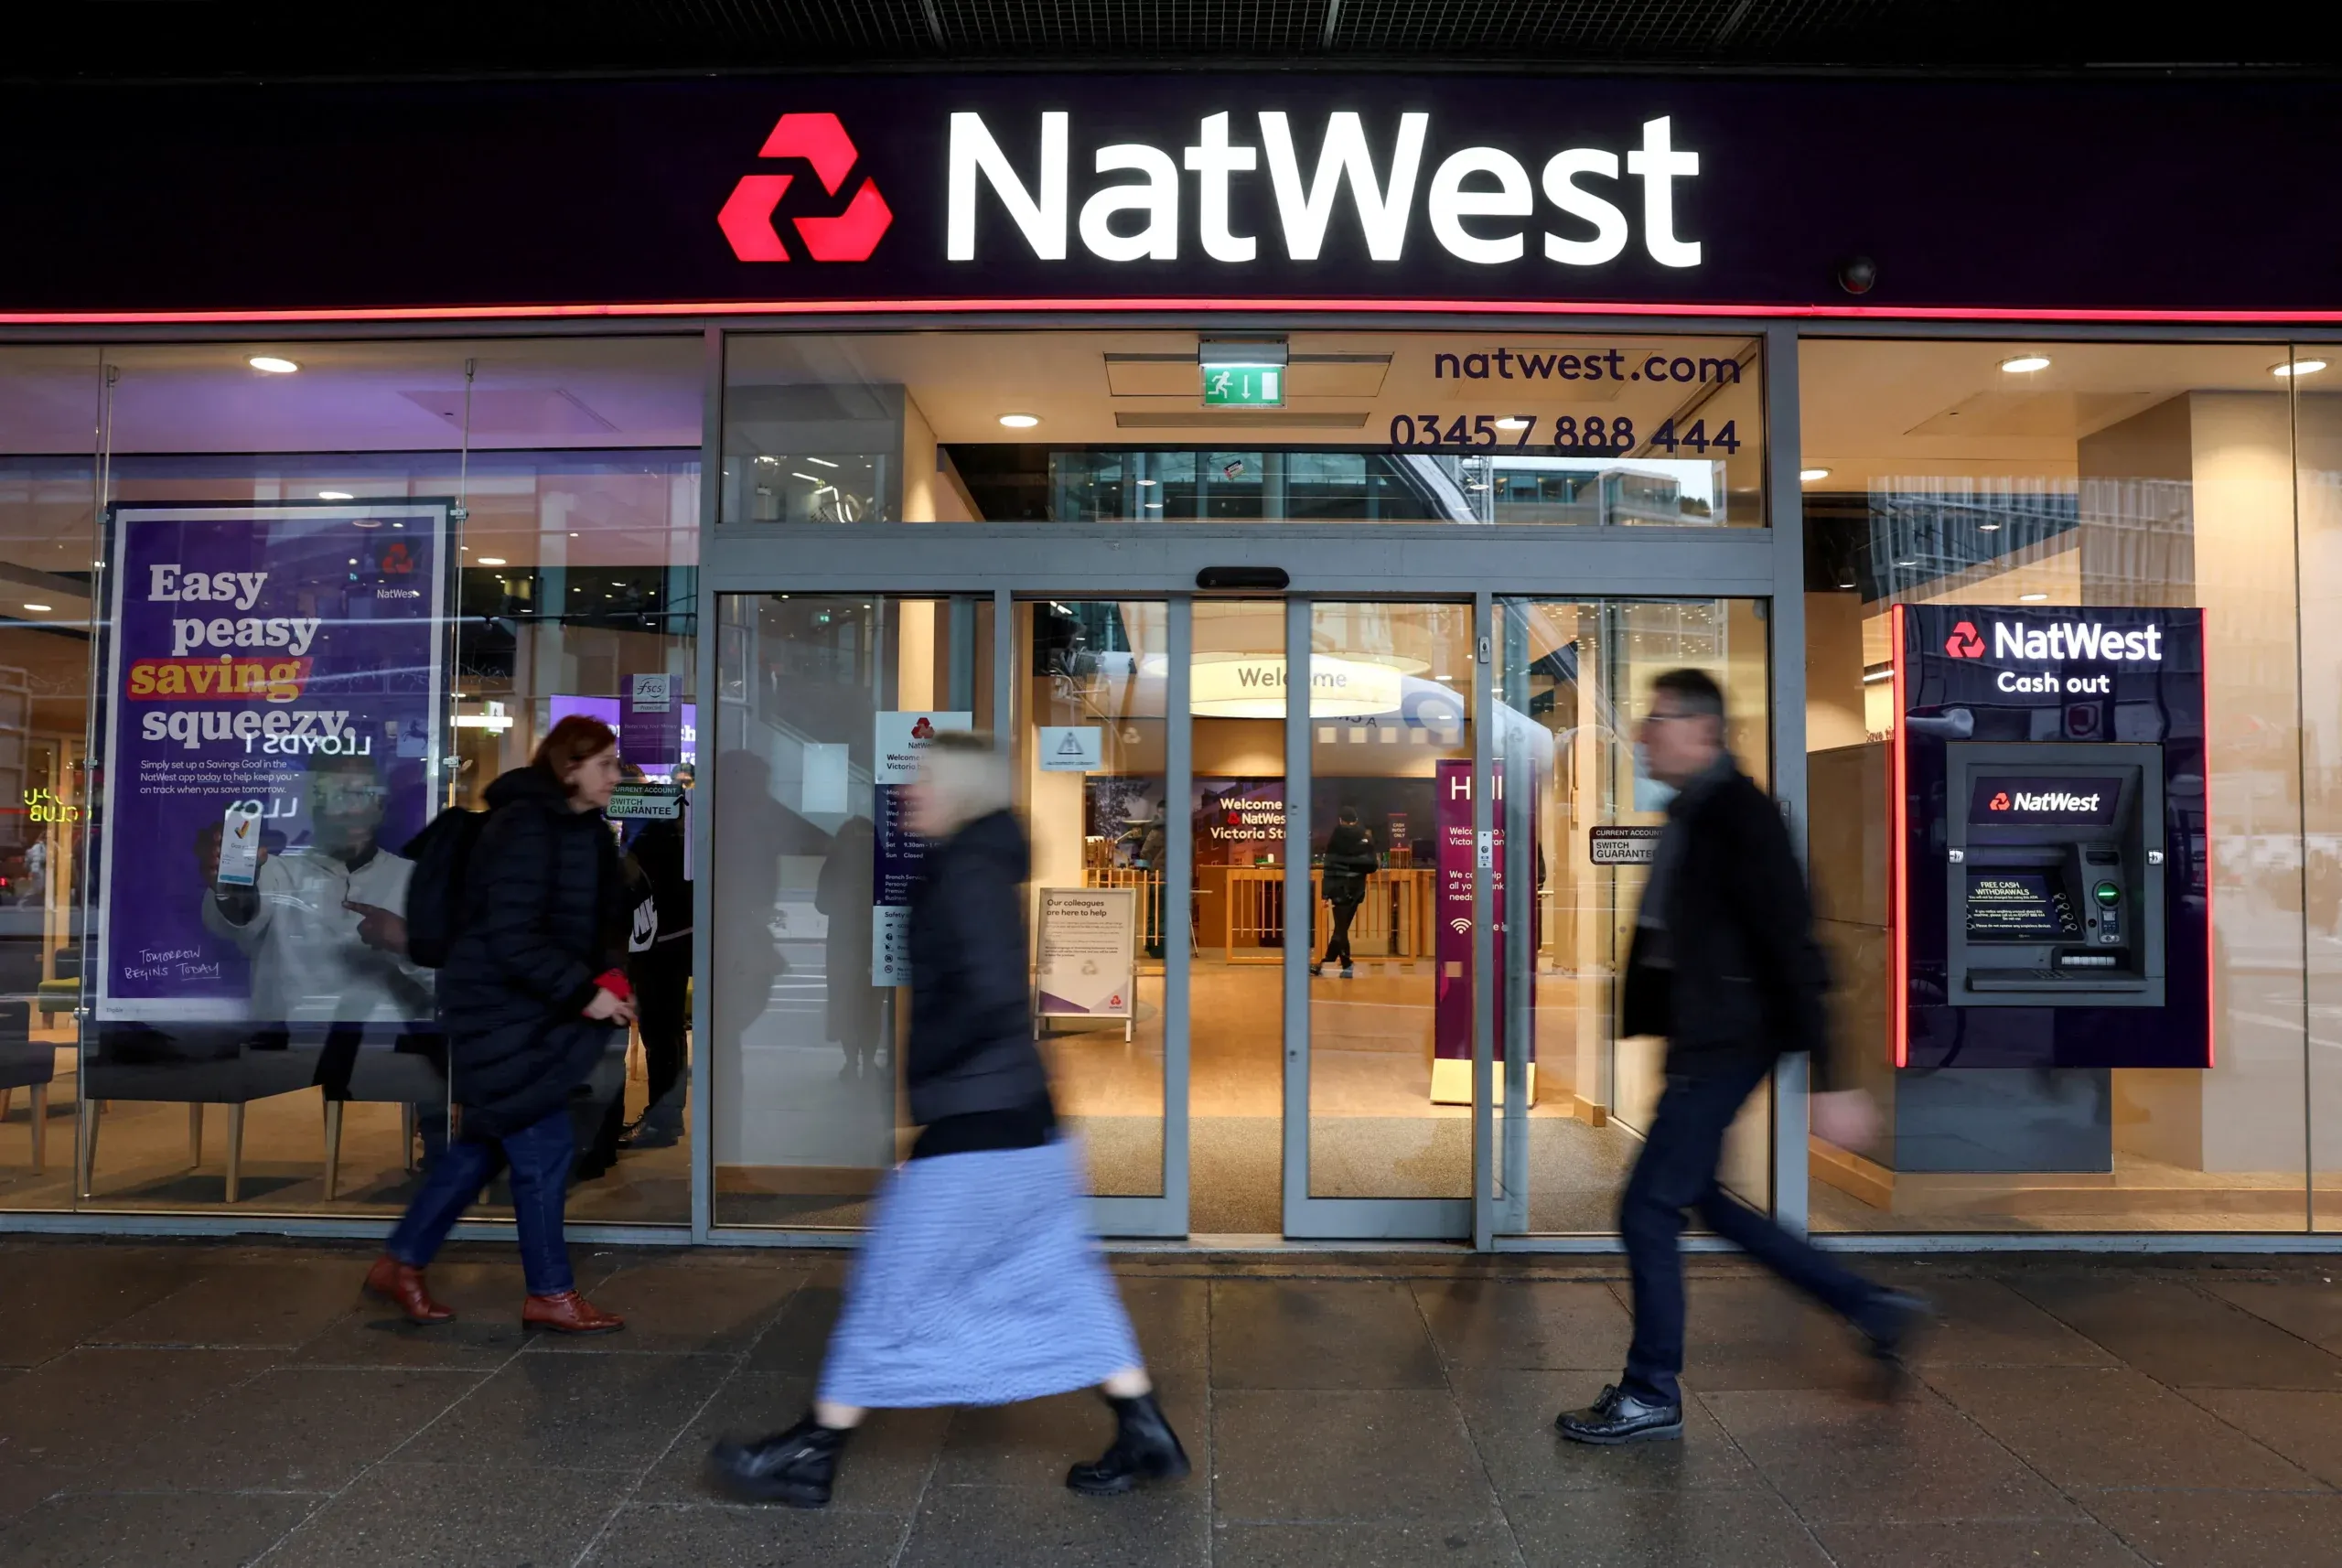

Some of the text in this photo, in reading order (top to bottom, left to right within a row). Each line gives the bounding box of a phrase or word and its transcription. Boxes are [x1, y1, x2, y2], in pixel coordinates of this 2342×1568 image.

[947, 110, 1702, 268] NatWest
[1434, 348, 1740, 383] natwest.com
[1390, 414, 1740, 455] 0345 7 888 444
[148, 564, 268, 611] Easy
[377, 589, 417, 599] NatWest
[172, 618, 321, 656] peasy
[1995, 622, 2162, 660] NatWest
[131, 654, 301, 703] saving
[1238, 667, 1348, 687] Welme
[1997, 671, 2111, 693] Cash out
[142, 710, 357, 749] squeezy.
[141, 760, 169, 770] Simply
[207, 759, 240, 770] Savings
[242, 759, 262, 768] Goal
[264, 759, 272, 768] in
[274, 760, 287, 768] the
[141, 773, 177, 781] NatWest
[179, 776, 196, 784] app
[198, 773, 221, 783] today
[234, 773, 252, 784] help
[253, 773, 274, 783] keep
[275, 775, 292, 783] you
[153, 785, 176, 794] track
[177, 785, 202, 794] when
[204, 788, 219, 796] you
[610, 806, 671, 815] GUARANTEE
[1220, 799, 1283, 810] Welcome
[2014, 792, 2100, 811] NatWest
[1242, 813, 1286, 824] NatWes
[1210, 828, 1265, 839] Victoria
[1596, 850, 1654, 858] GUARANTE
[1090, 909, 1107, 918] help
[139, 945, 201, 964] TOMORROW
[124, 962, 220, 981] BEGINS TODAY
